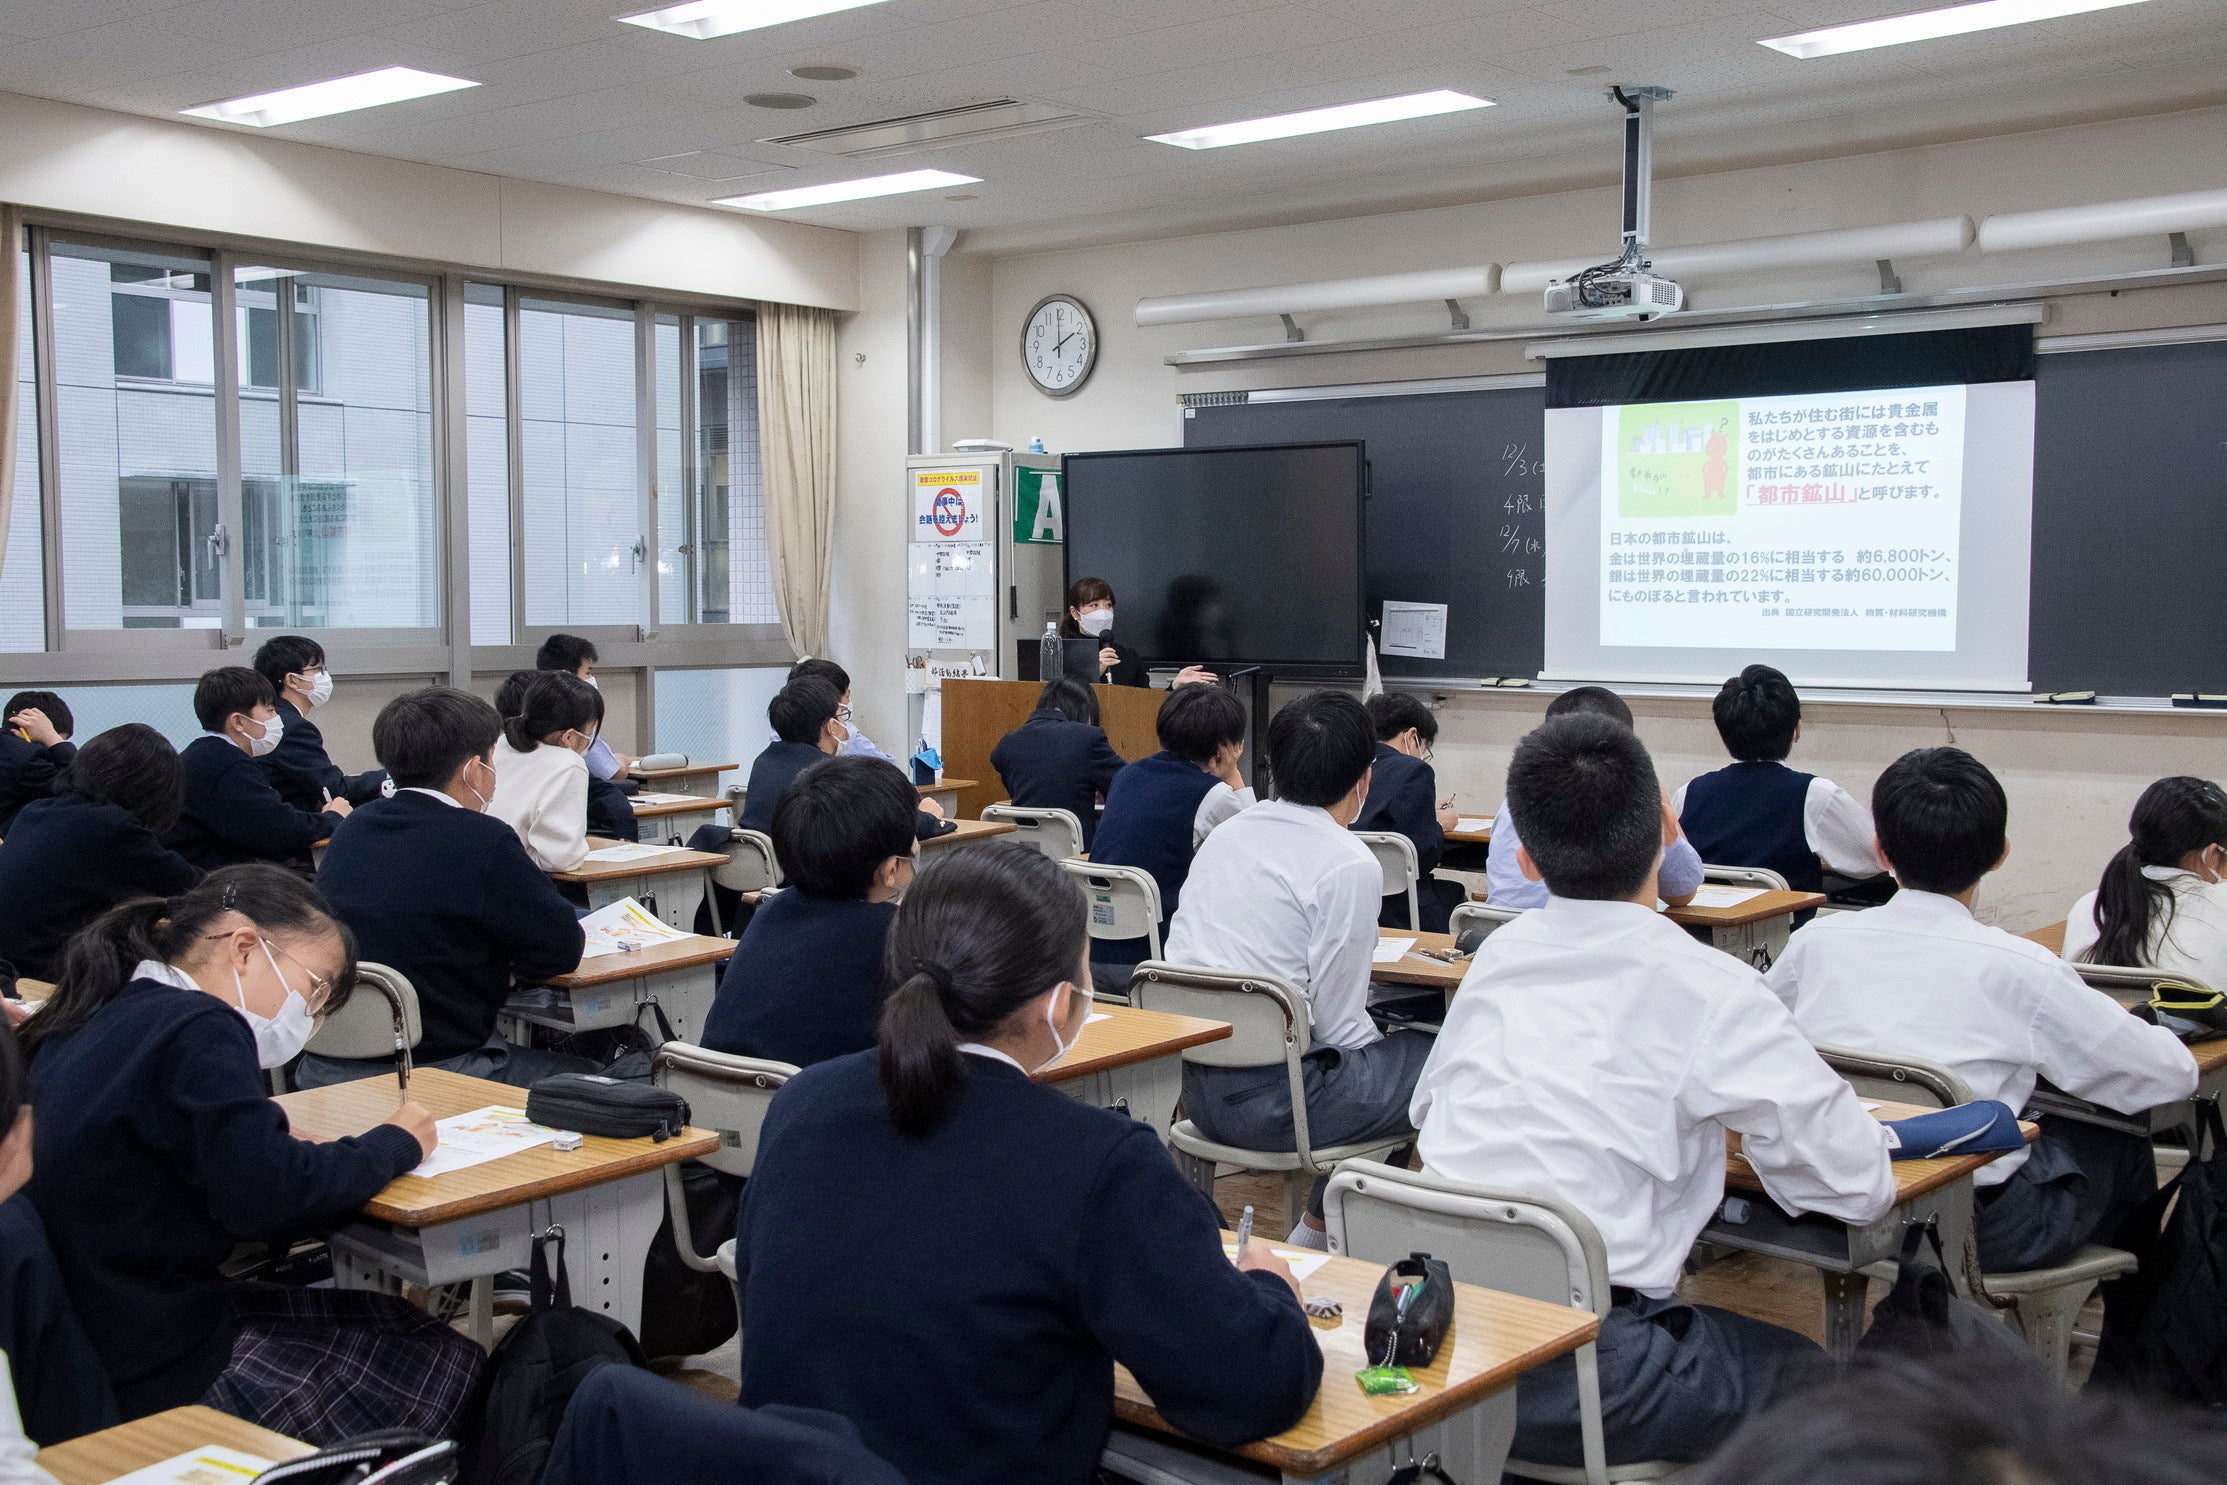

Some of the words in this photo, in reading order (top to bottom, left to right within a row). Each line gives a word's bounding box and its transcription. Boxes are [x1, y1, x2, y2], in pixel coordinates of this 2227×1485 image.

[1045, 311, 1052, 325] 11
[1035, 324, 1045, 338] 10
[1076, 321, 1083, 335] 2
[1033, 340, 1040, 353] 9
[1080, 337, 1087, 351] 3
[1036, 355, 1044, 369] 8
[1076, 353, 1083, 367] 4
[1046, 366, 1053, 379] 7
[1056, 369, 1063, 382] 6
[1067, 365, 1075, 378] 5
[1748, 401, 1938, 426] 私たちが住む街には貴金属
[1748, 421, 1940, 444] をはじめとする資源を含むも
[1747, 442, 1908, 462] のがたくさんあることを、
[1747, 460, 1930, 481] 都市にある鉱山にたとえて
[1031, 474, 1063, 540] A
[1610, 531, 1732, 546] 日本の都市鉱山は、
[1608, 589, 1790, 604] にものぼると言われています。
[1762, 608, 1780, 617] 出典
[1785, 608, 1859, 617] 国立研究開発法人
